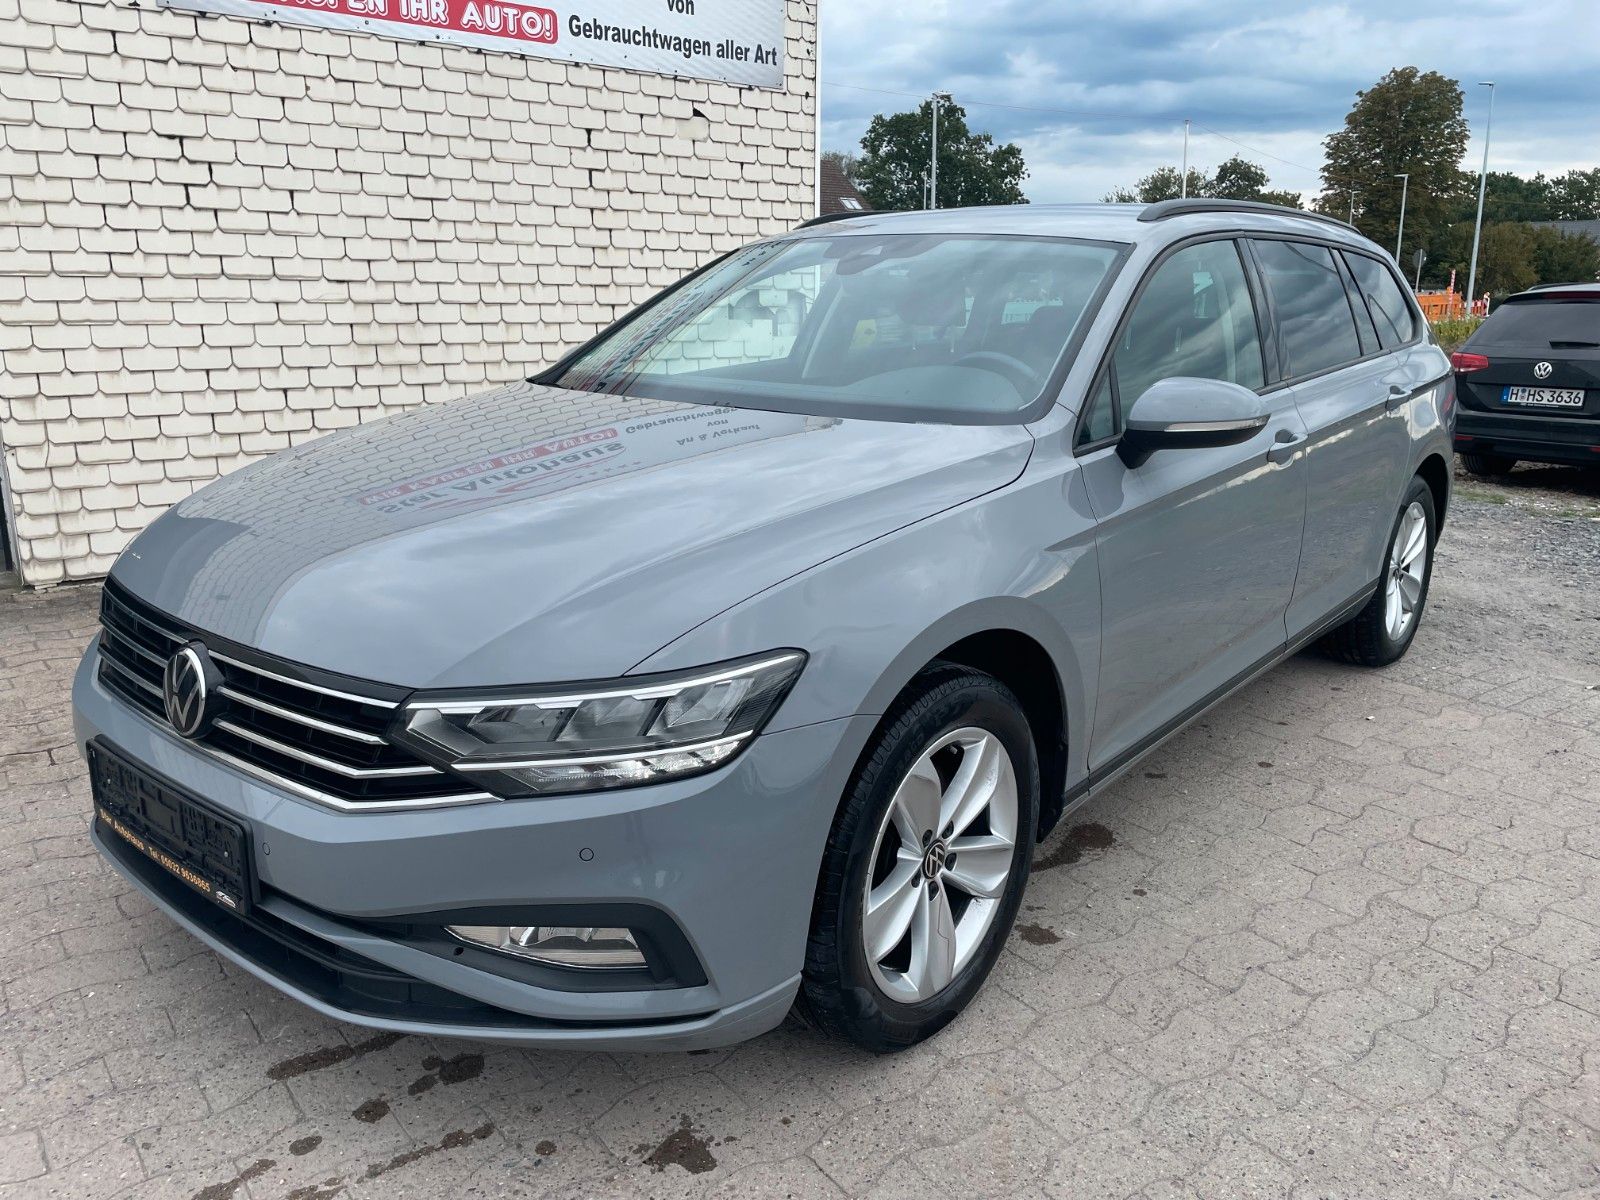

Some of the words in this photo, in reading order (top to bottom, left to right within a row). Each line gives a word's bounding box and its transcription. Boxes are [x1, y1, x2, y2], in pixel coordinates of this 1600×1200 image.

[400, 0, 449, 24] IHR
[461, 1, 554, 40] AUTO!
[667, 0, 695, 15] von
[568, 14, 711, 59] Gebrauchtwagen
[716, 39, 751, 62] aller
[754, 44, 778, 66] Art
[1510, 388, 1520, 401] H
[1526, 388, 1545, 402] HS
[1547, 390, 1581, 405] 3636
